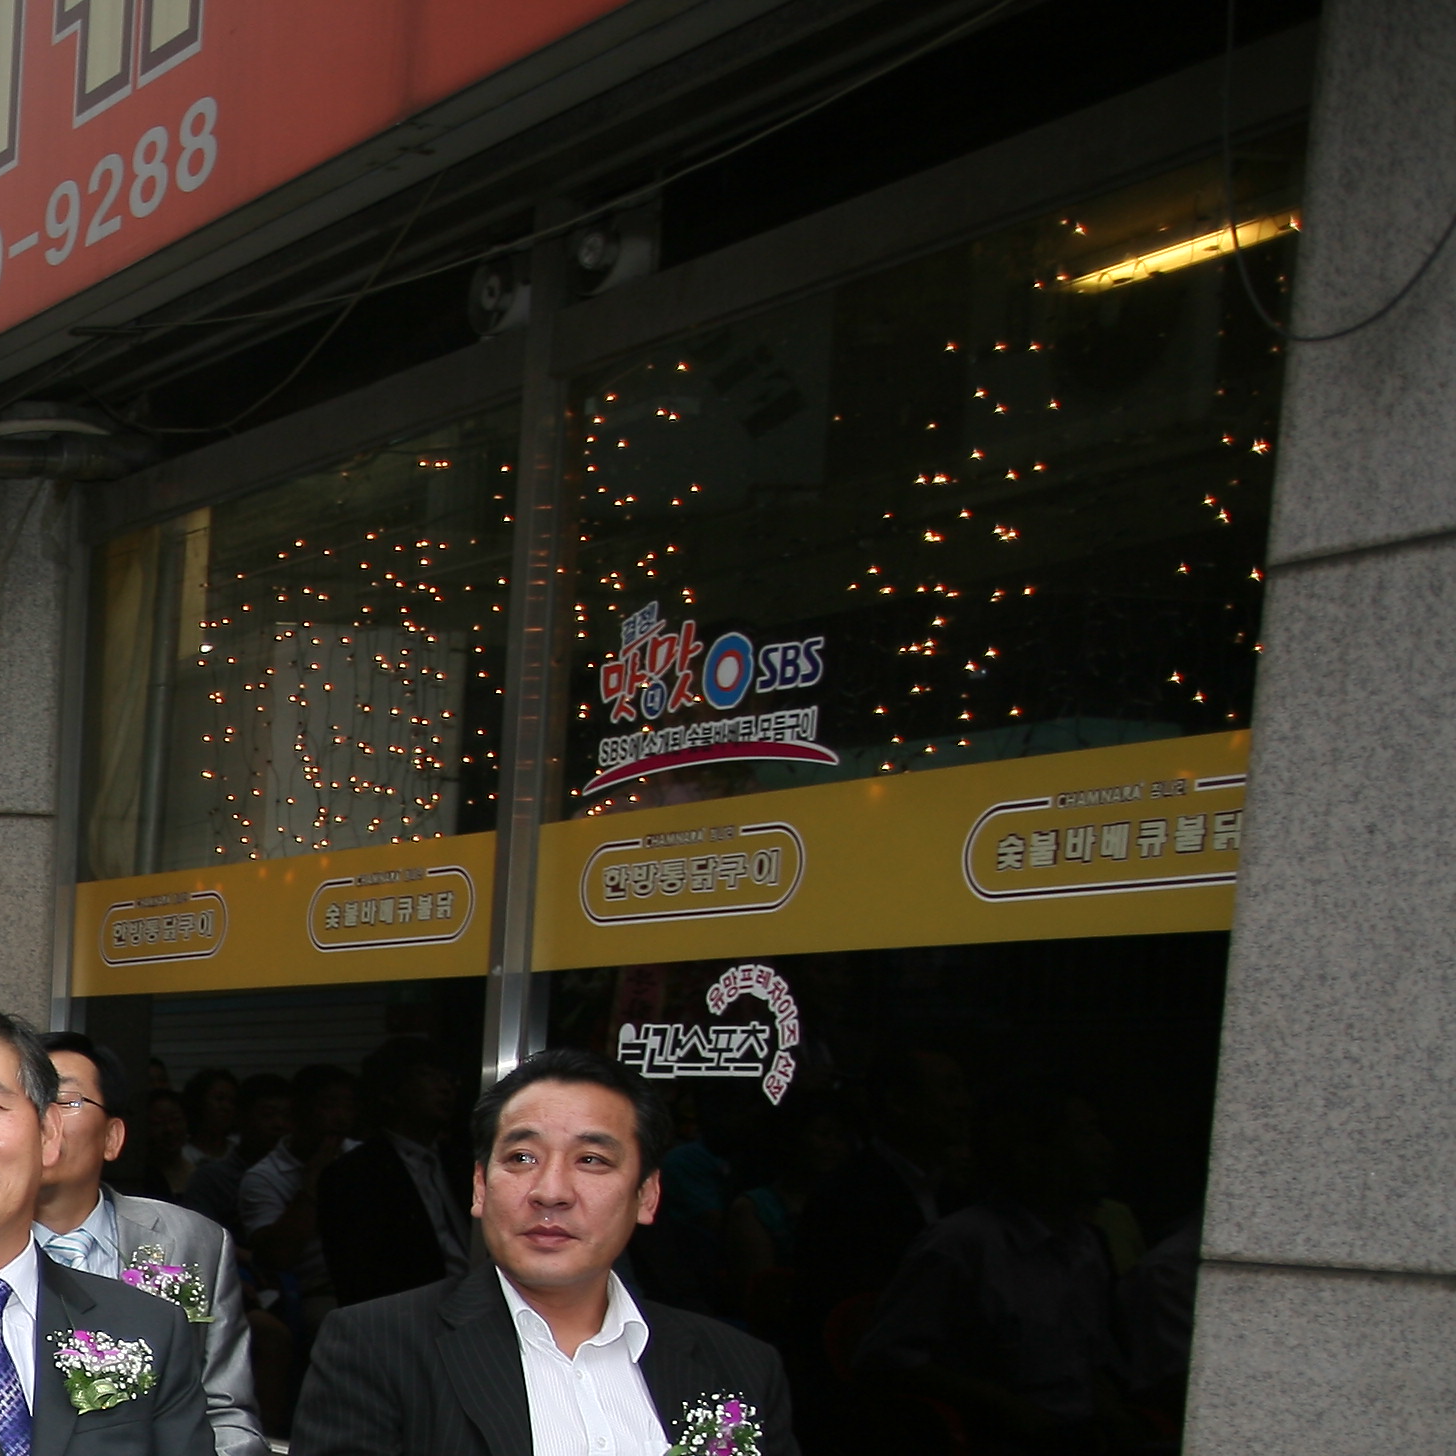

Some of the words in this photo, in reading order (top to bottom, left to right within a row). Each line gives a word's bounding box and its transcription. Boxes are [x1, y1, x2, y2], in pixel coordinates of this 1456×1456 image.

[755, 637, 825, 693] SBS
[1055, 781, 1144, 809] CHAMNARA
[602, 846, 783, 902] 한방통닭구이
